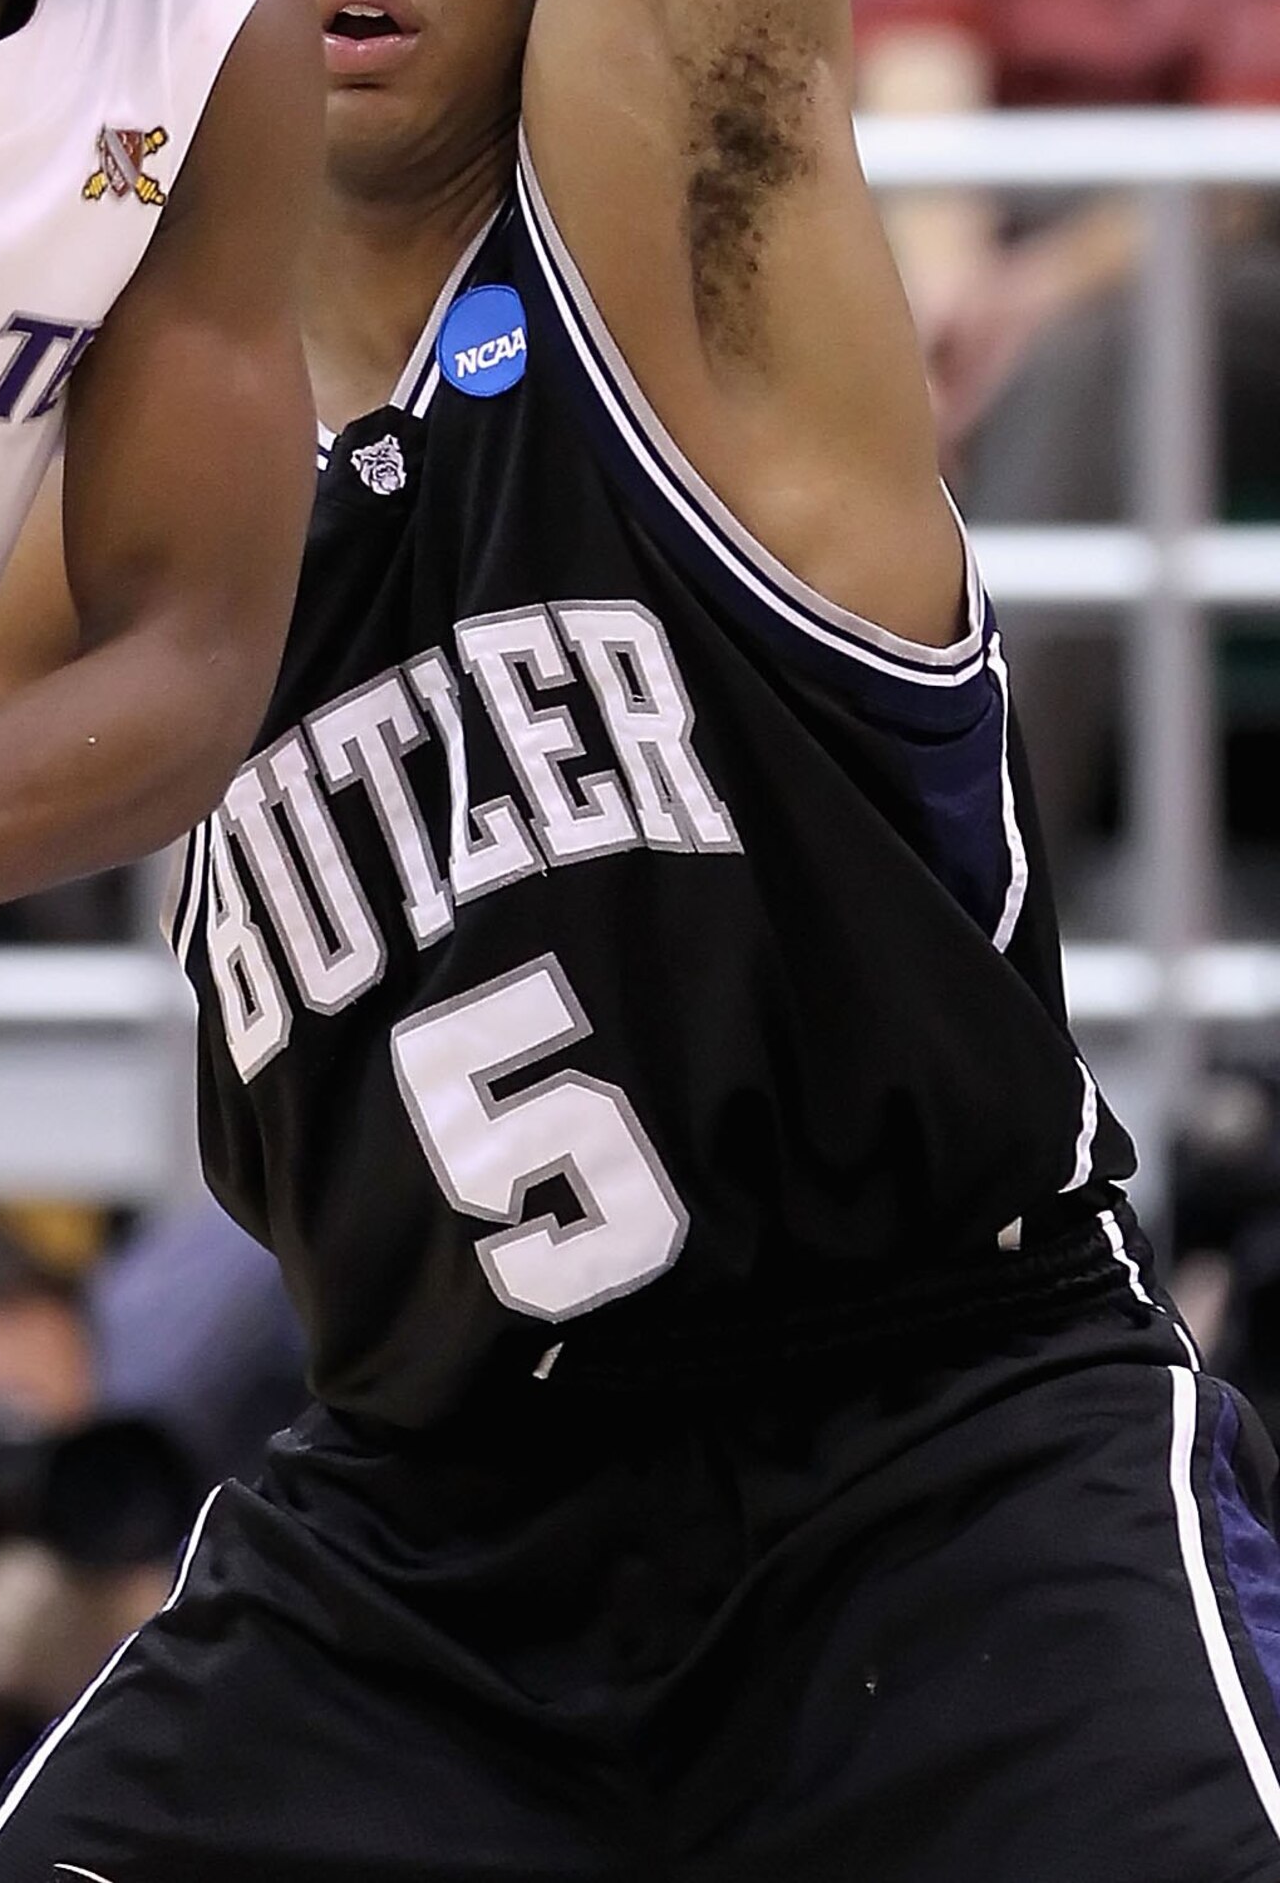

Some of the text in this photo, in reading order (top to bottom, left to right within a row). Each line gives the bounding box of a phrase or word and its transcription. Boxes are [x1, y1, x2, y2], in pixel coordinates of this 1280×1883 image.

[454, 326, 527, 378] NCAA
[207, 599, 744, 1084] BUTLER
[391, 951, 692, 1324] 5
